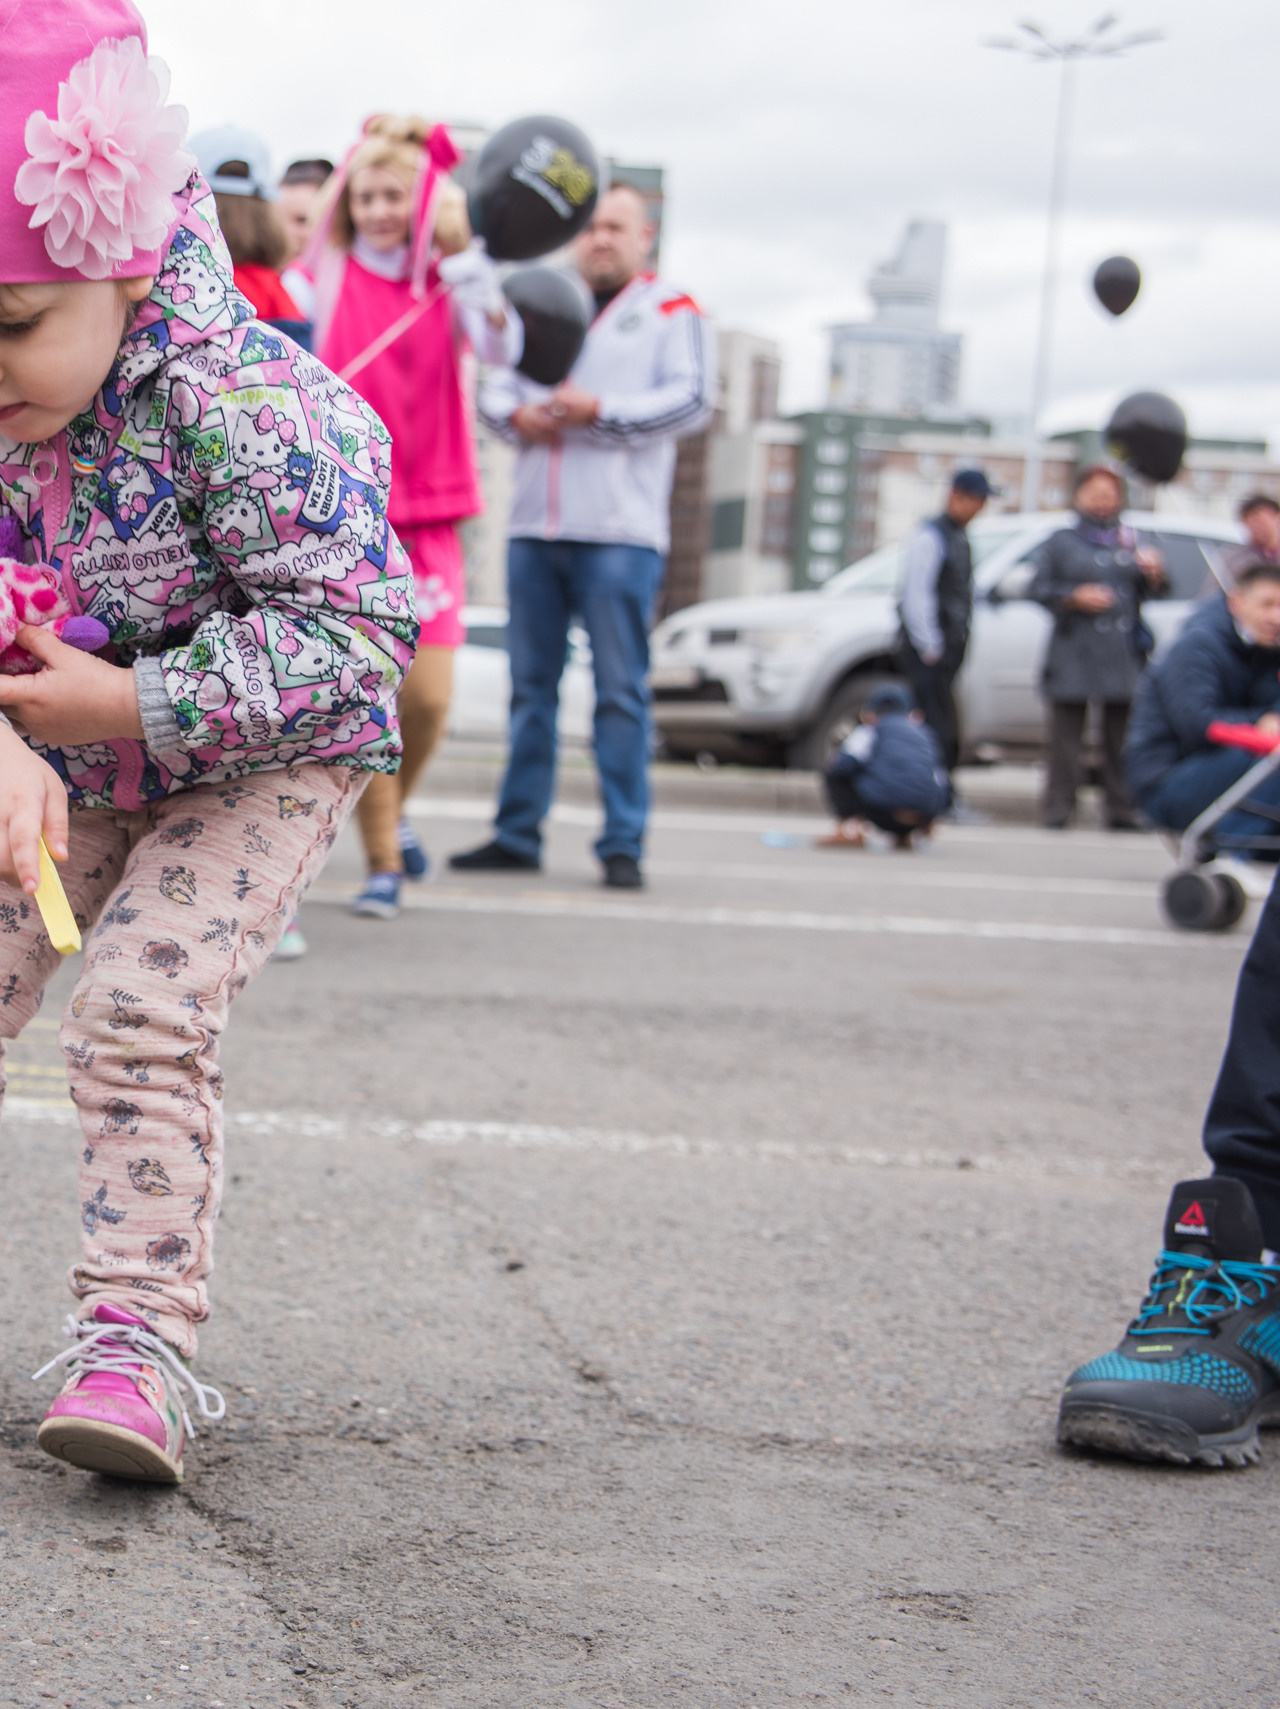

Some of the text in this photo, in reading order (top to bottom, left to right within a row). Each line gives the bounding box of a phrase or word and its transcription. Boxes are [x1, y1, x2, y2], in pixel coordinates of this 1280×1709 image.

[308, 491, 322, 508] WE
[320, 464, 337, 517] SHOPPING
[74, 552, 131, 578] KITTY
[293, 537, 358, 576] KITTY
[233, 630, 264, 696] HELLO
